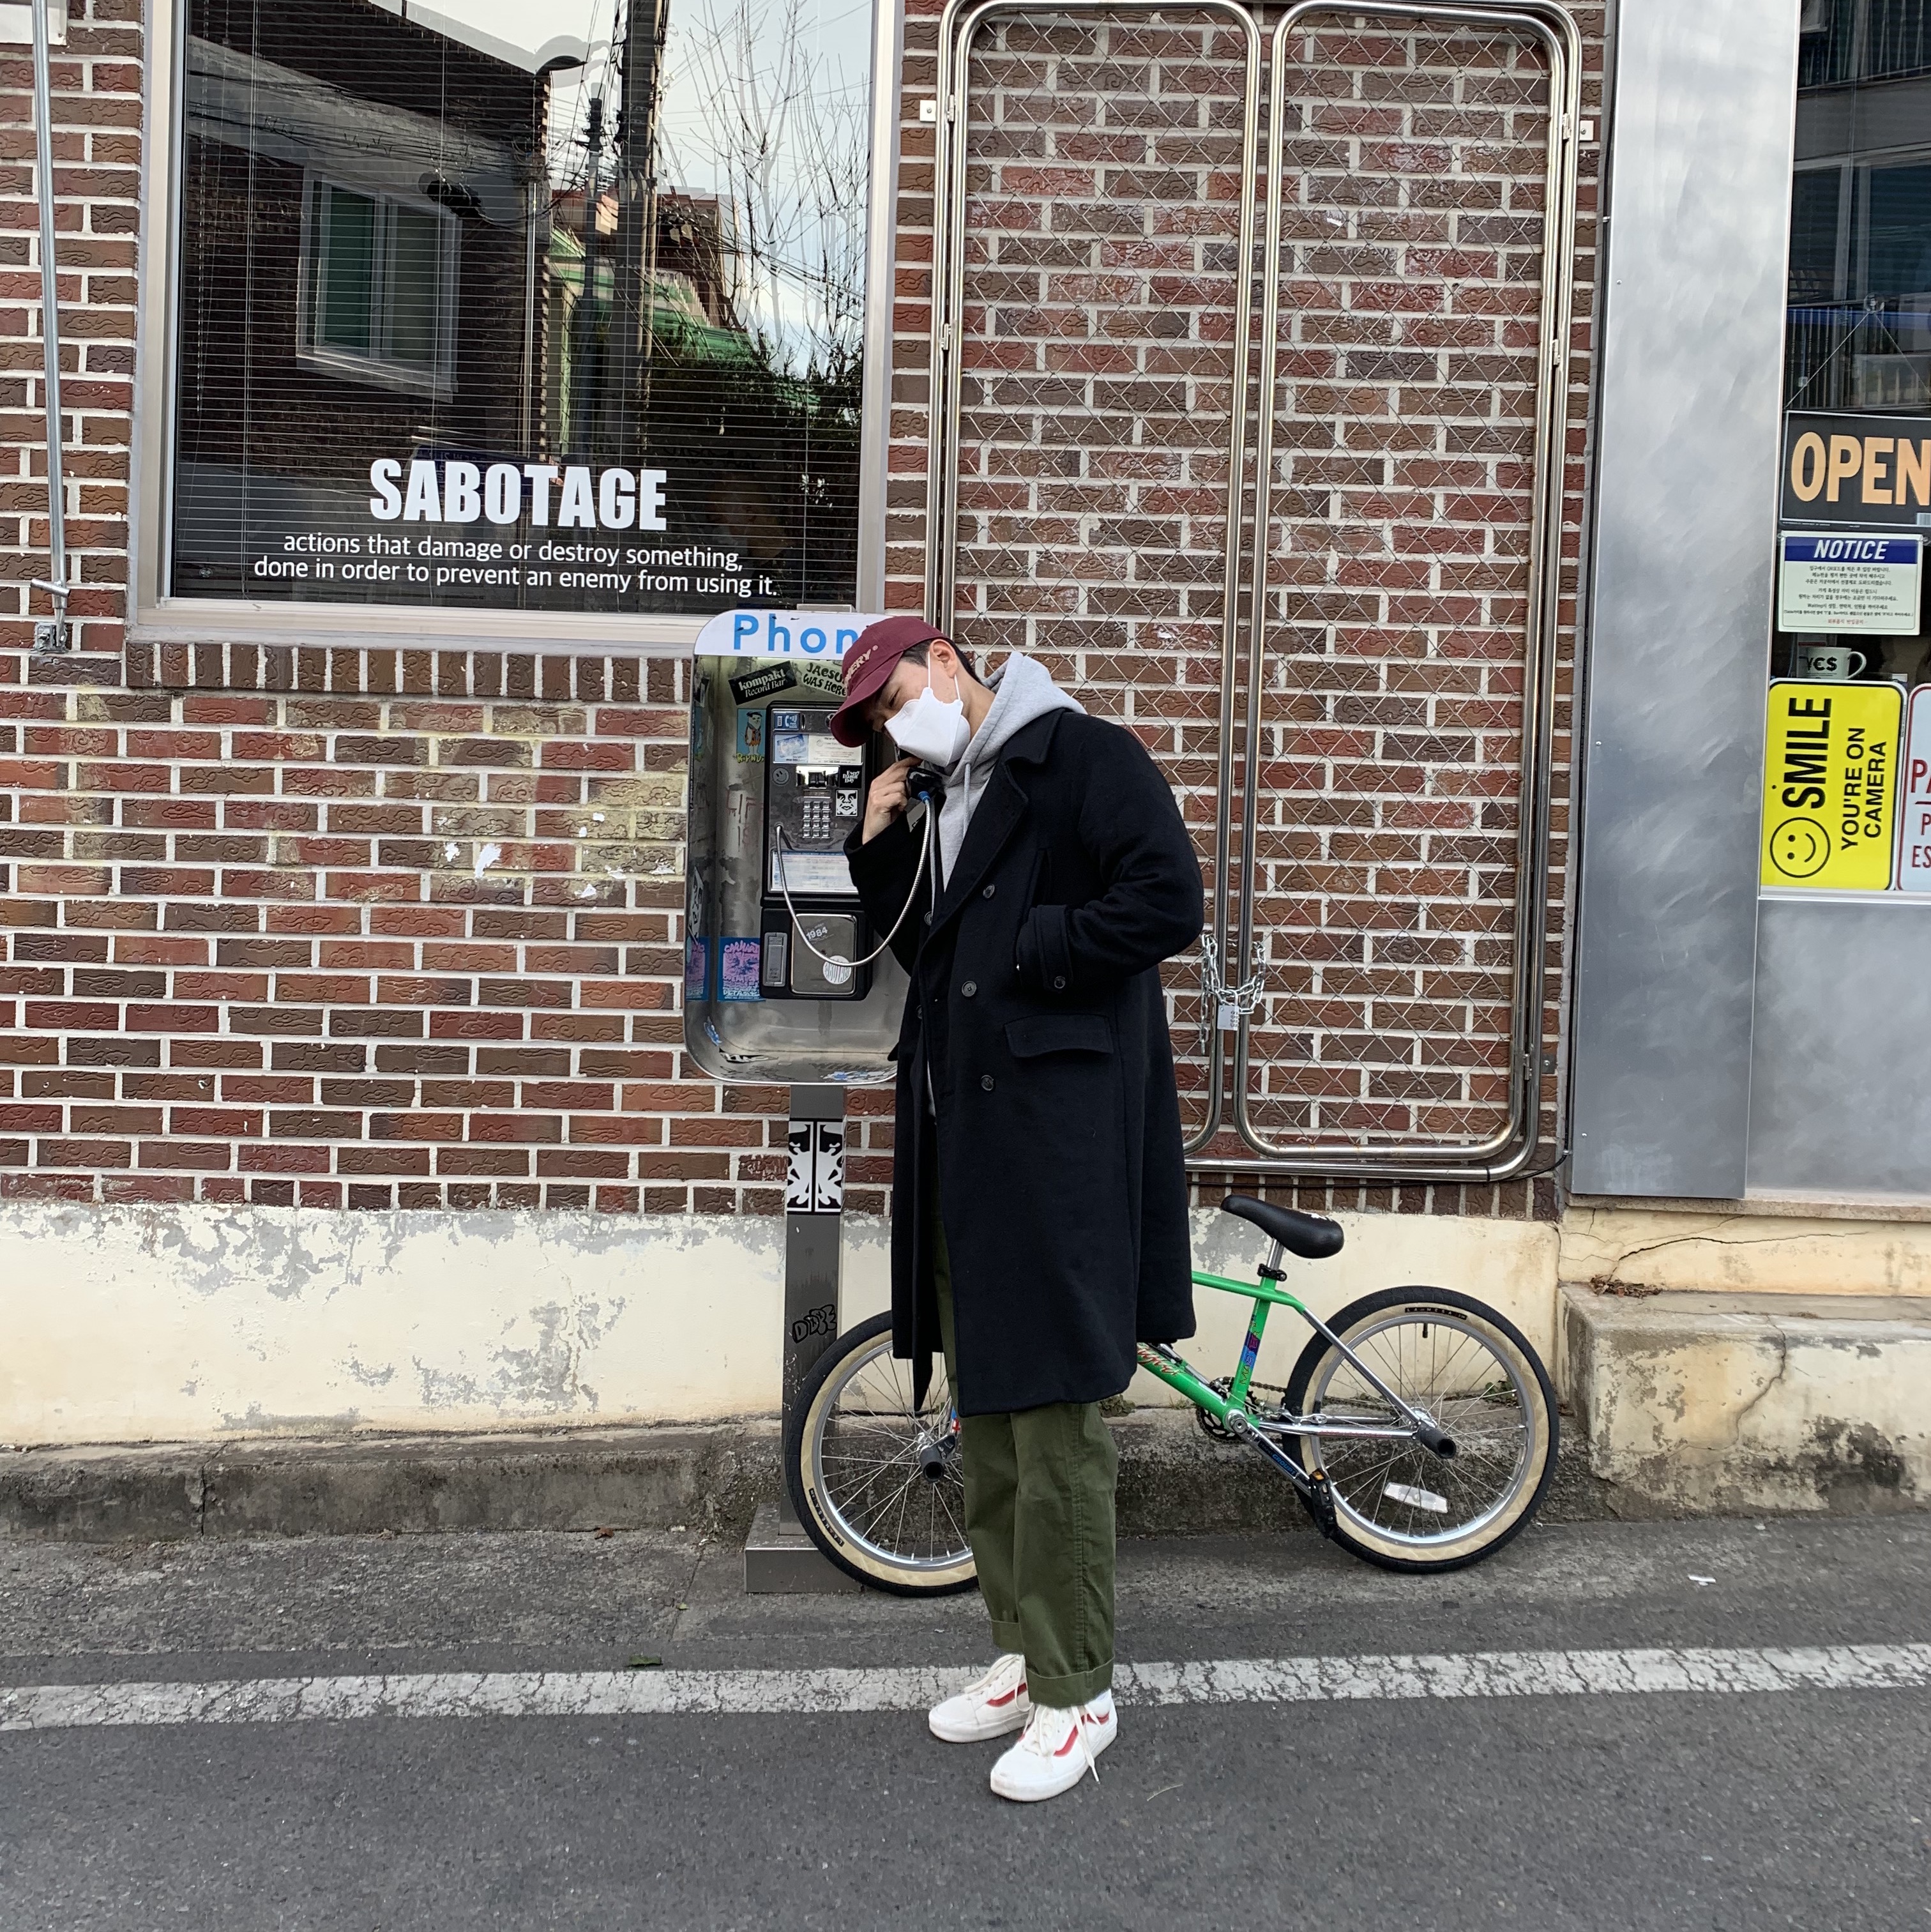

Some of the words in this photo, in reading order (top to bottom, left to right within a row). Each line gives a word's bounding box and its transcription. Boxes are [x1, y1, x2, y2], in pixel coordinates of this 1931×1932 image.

[1791, 431, 1931, 506] OPEN
[369, 459, 667, 531] SABOTAGE
[283, 532, 360, 554] actions
[367, 533, 411, 555] that
[418, 535, 503, 561] damage
[509, 544, 533, 559] or
[539, 540, 620, 567] destroy
[626, 546, 743, 572] something,
[1814, 539, 1889, 560] NOTICE
[254, 555, 308, 577] done
[315, 558, 334, 579] in
[342, 559, 400, 581] order
[406, 562, 429, 582] to
[437, 565, 520, 586] prevent
[526, 570, 552, 586] an
[559, 572, 632, 593] enemy
[638, 570, 688, 591] from
[696, 574, 752, 598] using
[759, 575, 778, 596] it.
[738, 668, 786, 691] kompakt
[745, 684, 770, 698] Record
[771, 678, 785, 690] Bar
[1782, 697, 1832, 809] SMILE
[1846, 727, 1865, 761] ON
[1841, 766, 1863, 851] YOU'RE
[1863, 741, 1887, 838] CAMERA
[806, 926, 828, 940] 1984
